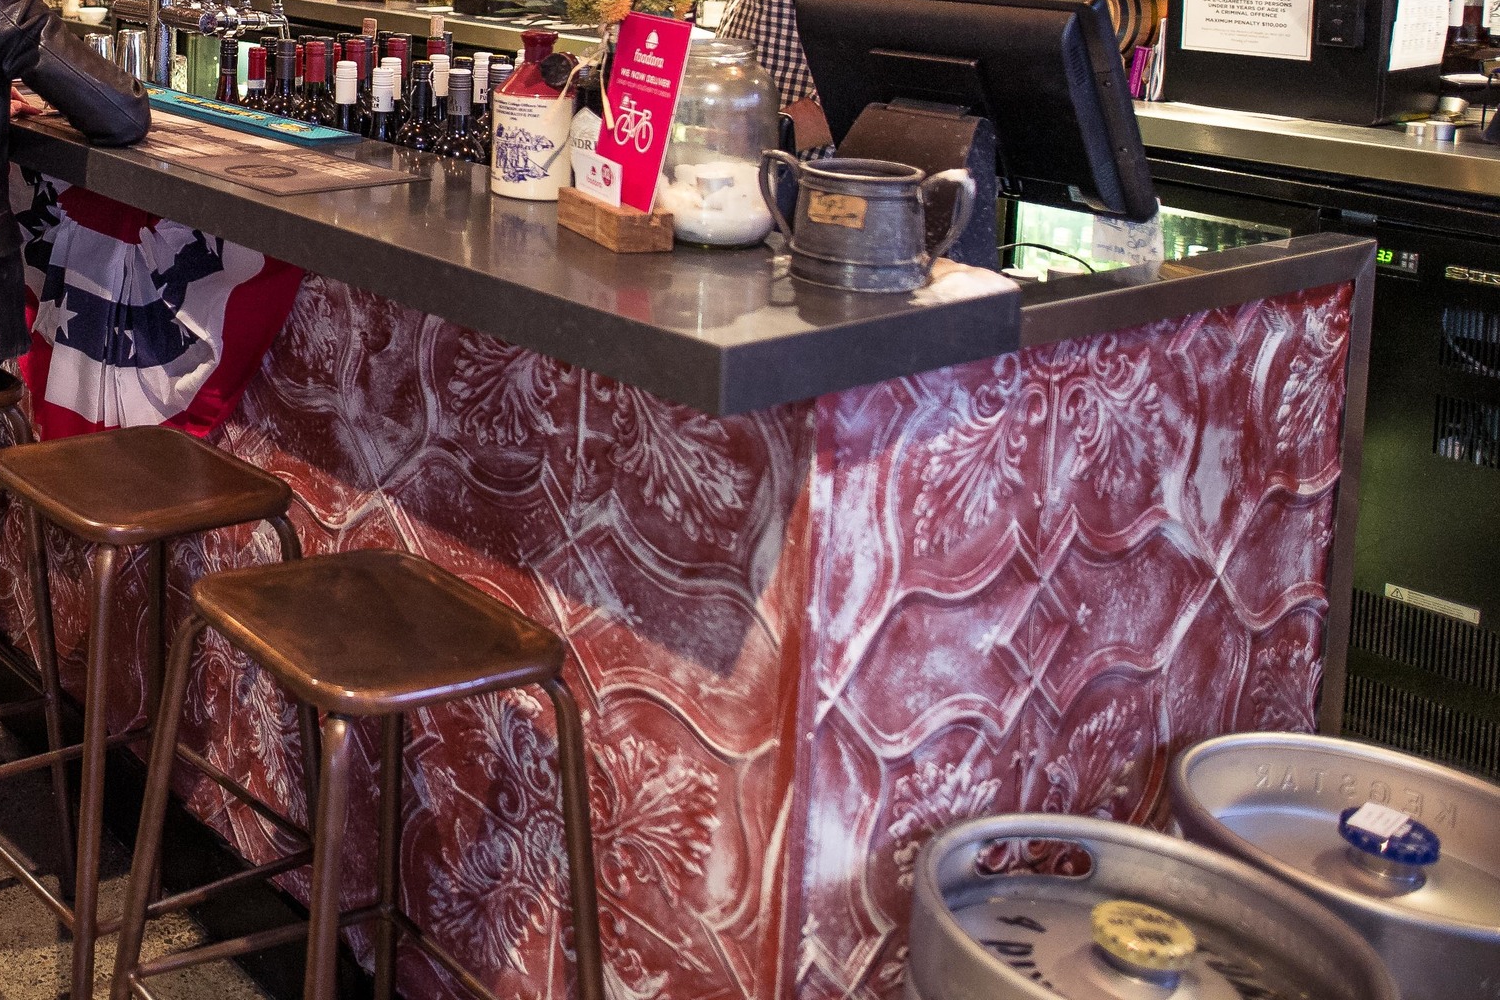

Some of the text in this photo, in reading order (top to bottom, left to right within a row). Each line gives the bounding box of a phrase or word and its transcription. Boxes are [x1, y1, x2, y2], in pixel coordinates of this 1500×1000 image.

[634, 48, 664, 69] foodora
[620, 68, 672, 88] WE NOW DELIVER
